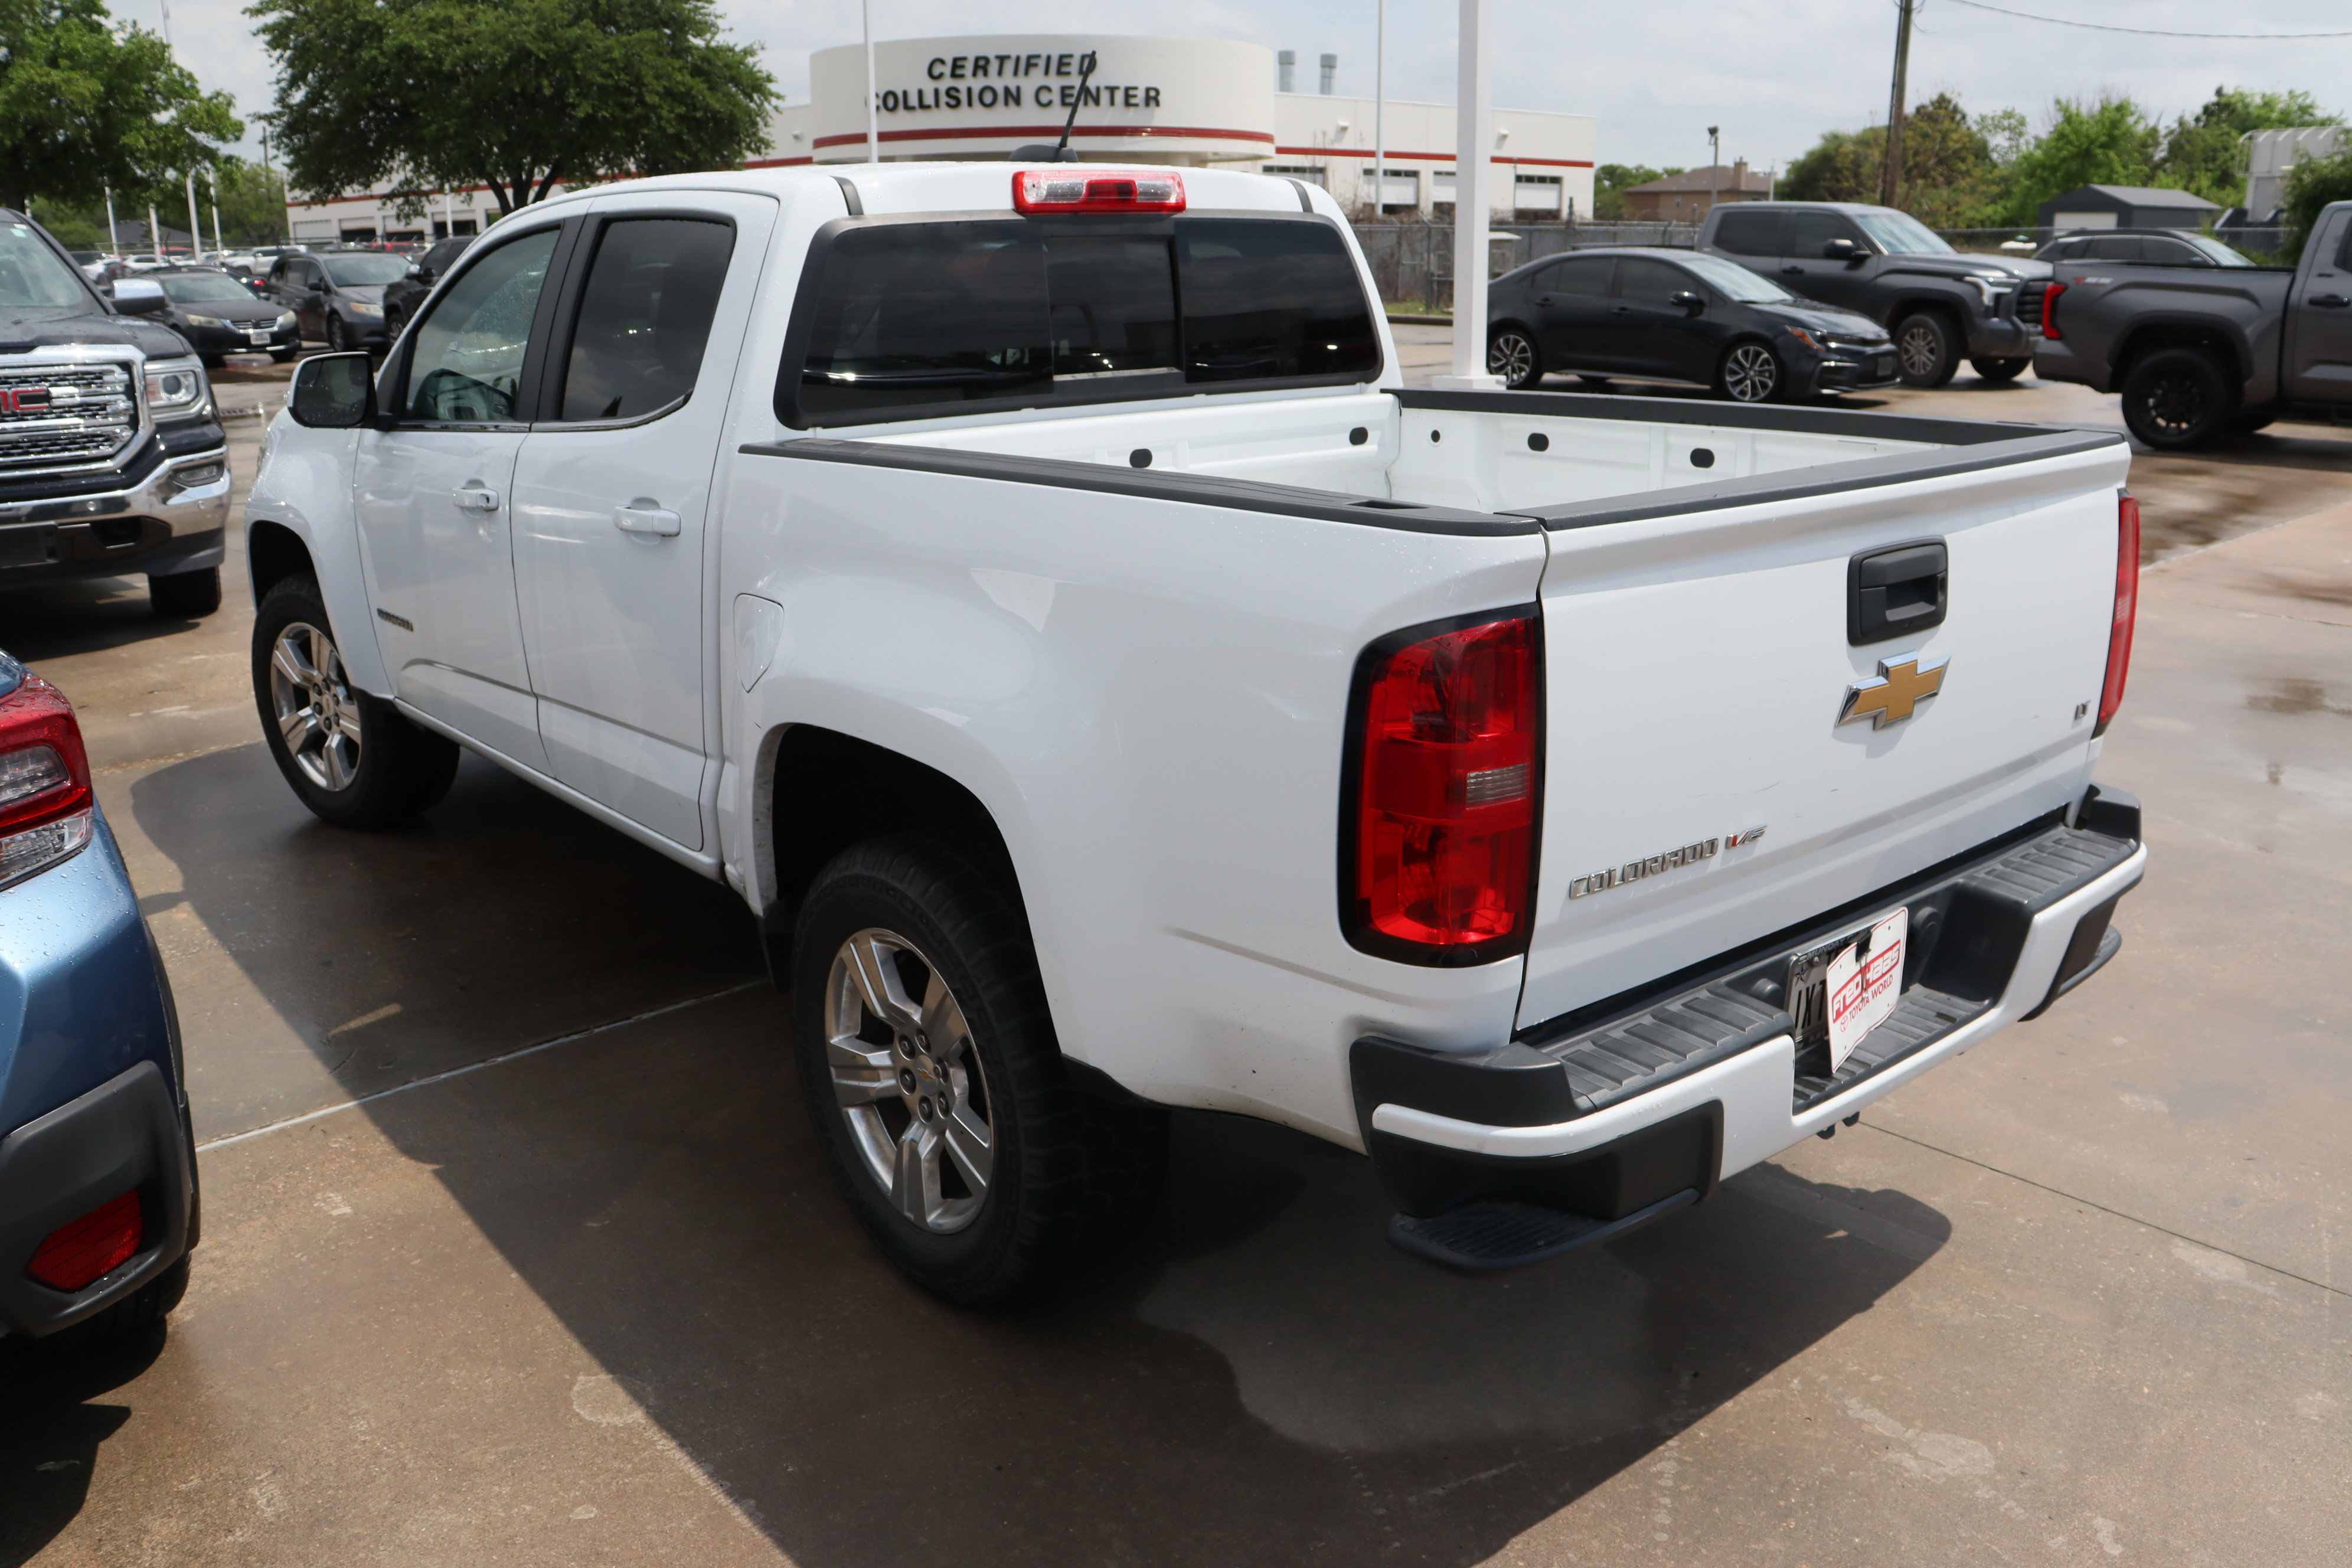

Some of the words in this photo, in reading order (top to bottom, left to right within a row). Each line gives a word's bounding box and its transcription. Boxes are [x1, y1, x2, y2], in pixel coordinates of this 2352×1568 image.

[927, 53, 1097, 80] CERTIFIED
[1034, 84, 1161, 107] CENTER
[1569, 837, 1719, 900] COLORADO
[1725, 824, 1768, 850] V6
[1849, 995, 1870, 1022] TOYOTA
[1871, 974, 1893, 1000] WORLD
